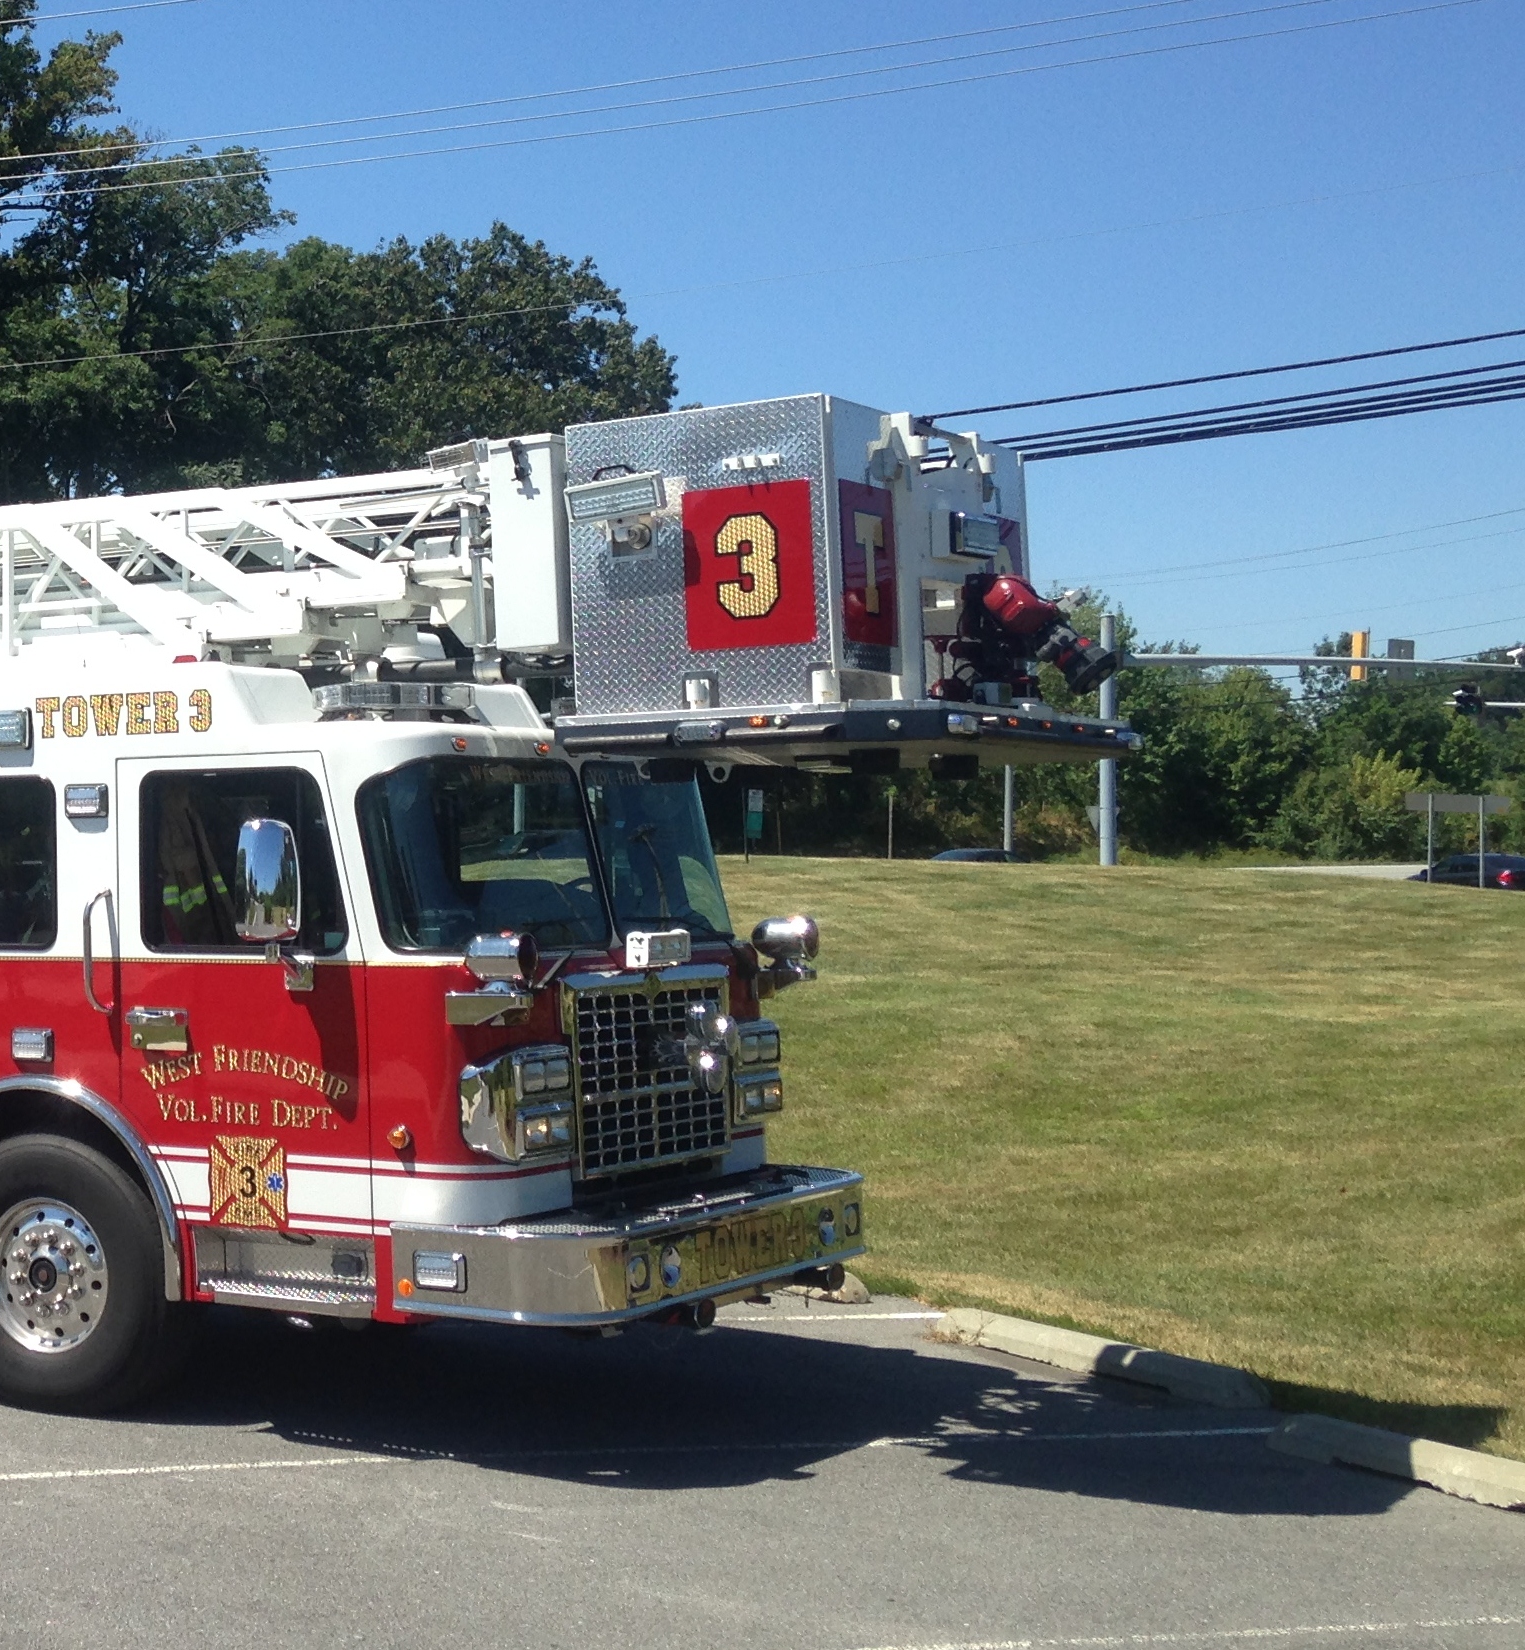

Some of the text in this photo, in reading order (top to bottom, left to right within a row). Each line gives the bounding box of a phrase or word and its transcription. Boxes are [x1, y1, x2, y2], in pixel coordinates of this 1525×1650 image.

[714, 512, 780, 621] 3
[35, 688, 213, 739] TOWER 3
[139, 1044, 350, 1101] WEST FRIENDSHIP
[155, 1092, 339, 1131] VOL. FIRE DEPT.
[239, 1165, 258, 1199] 3
[694, 1210, 788, 1285] TOWER
